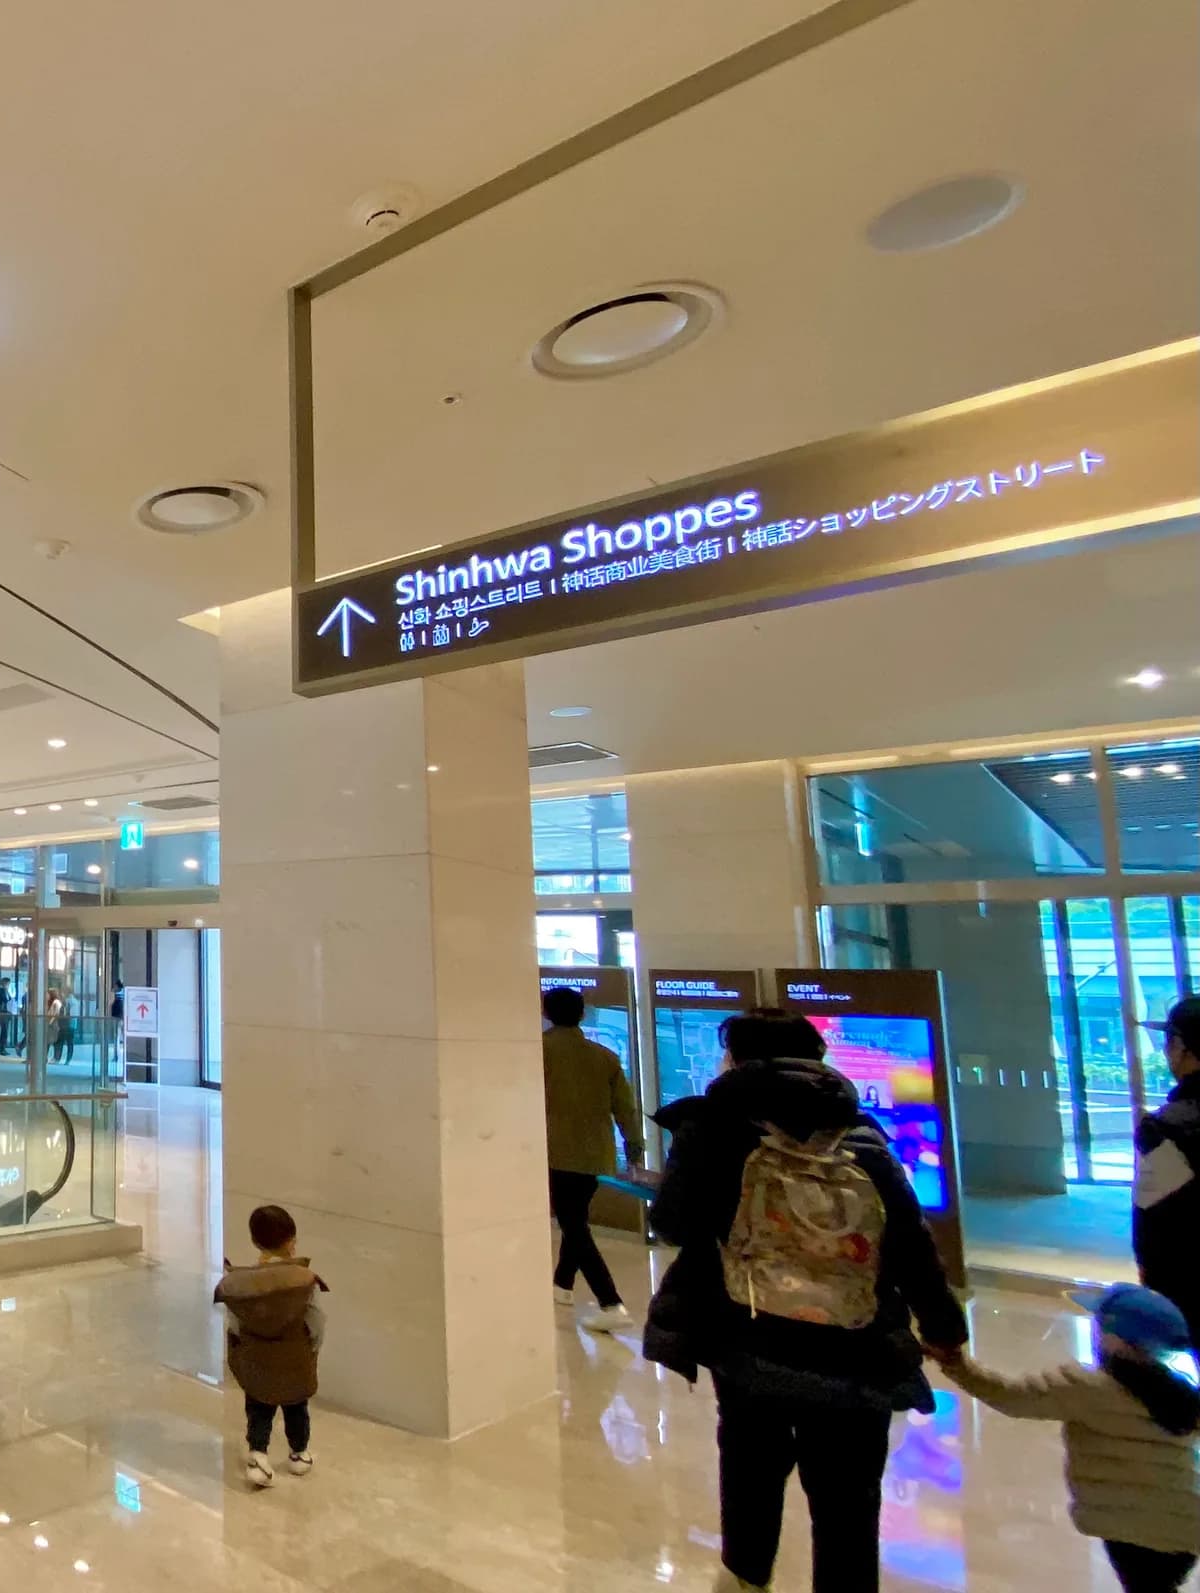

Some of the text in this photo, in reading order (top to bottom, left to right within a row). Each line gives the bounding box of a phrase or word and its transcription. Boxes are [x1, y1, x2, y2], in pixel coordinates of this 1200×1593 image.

[397, 447, 1104, 631] 신화 쇼핑스트리트 神话商业美食街 神話ショッピングストリート
[394, 489, 761, 606] Shinhwa Shoppes
[540, 977, 597, 988] INFORMATION
[656, 980, 716, 991] FLOOR GUIDE
[787, 983, 820, 993] EVENT
